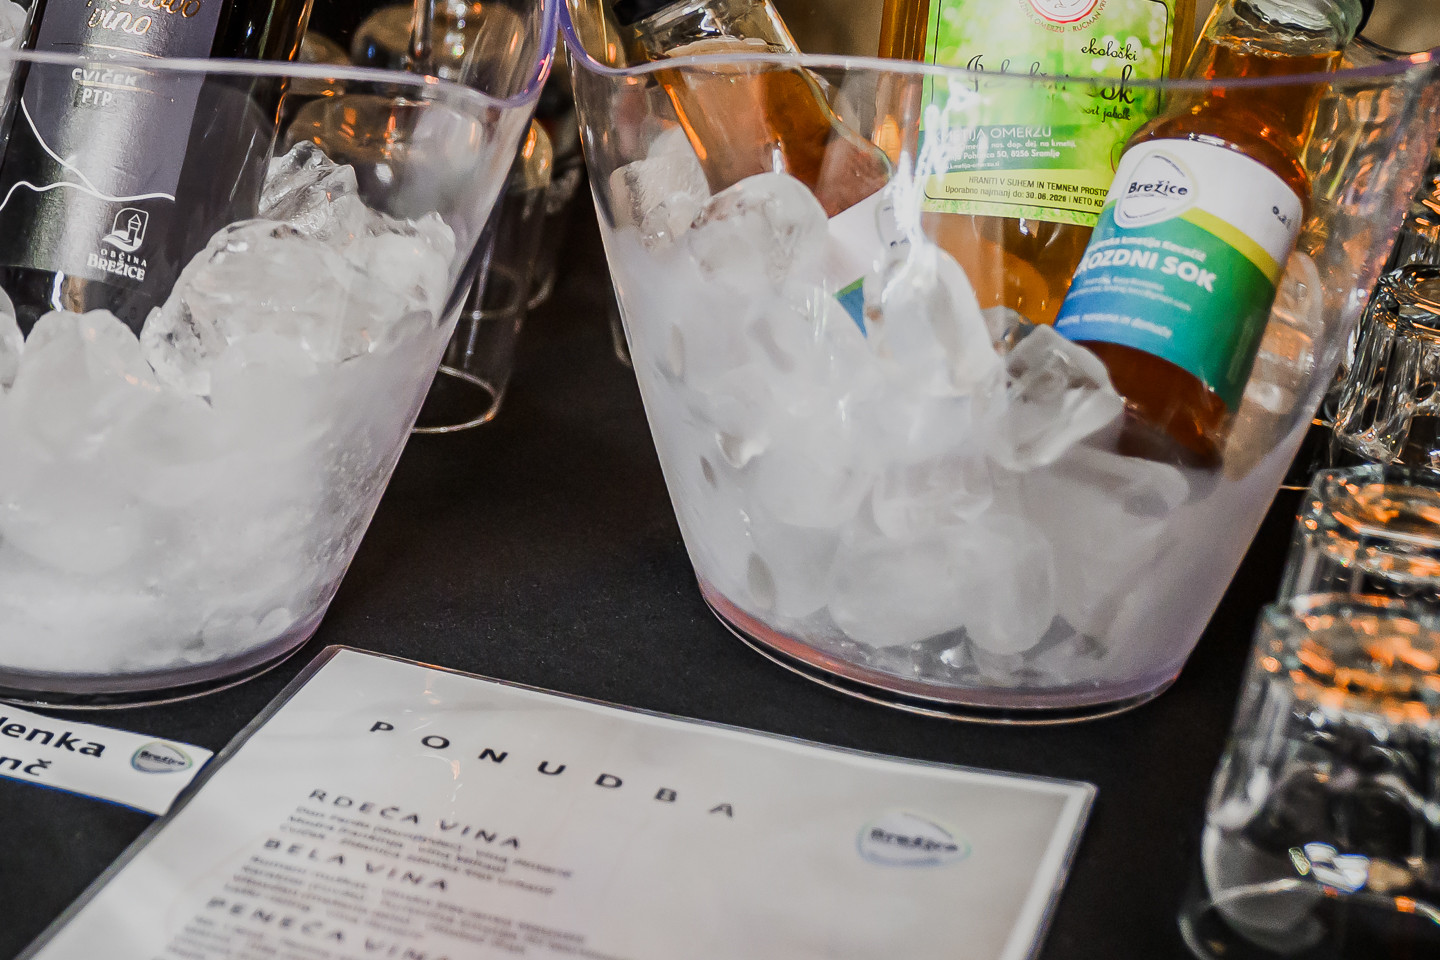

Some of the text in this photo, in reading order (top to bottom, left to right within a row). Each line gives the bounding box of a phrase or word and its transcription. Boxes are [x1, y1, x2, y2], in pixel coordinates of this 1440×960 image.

[88, 6, 152, 36] vino
[1081, 38, 1138, 62] ekološki
[71, 68, 138, 87] CVIČEK
[82, 88, 113, 106] PTP
[969, 176, 998, 185] HRANITI
[1007, 178, 1034, 188] SUHEM
[1037, 181, 1044, 189] IN
[1047, 182, 1078, 193] TEMNEM
[1128, 180, 1188, 197] Brežice
[945, 186, 978, 194] Uporabno
[980, 188, 1011, 198] najmanj
[1073, 196, 1092, 206] NETO
[100, 248, 147, 268] OBČINA
[1161, 256, 1217, 293] SOK
[369, 721, 734, 818] PONUDBA
[440, 819, 520, 850] VINA
[365, 861, 449, 892] VINA
